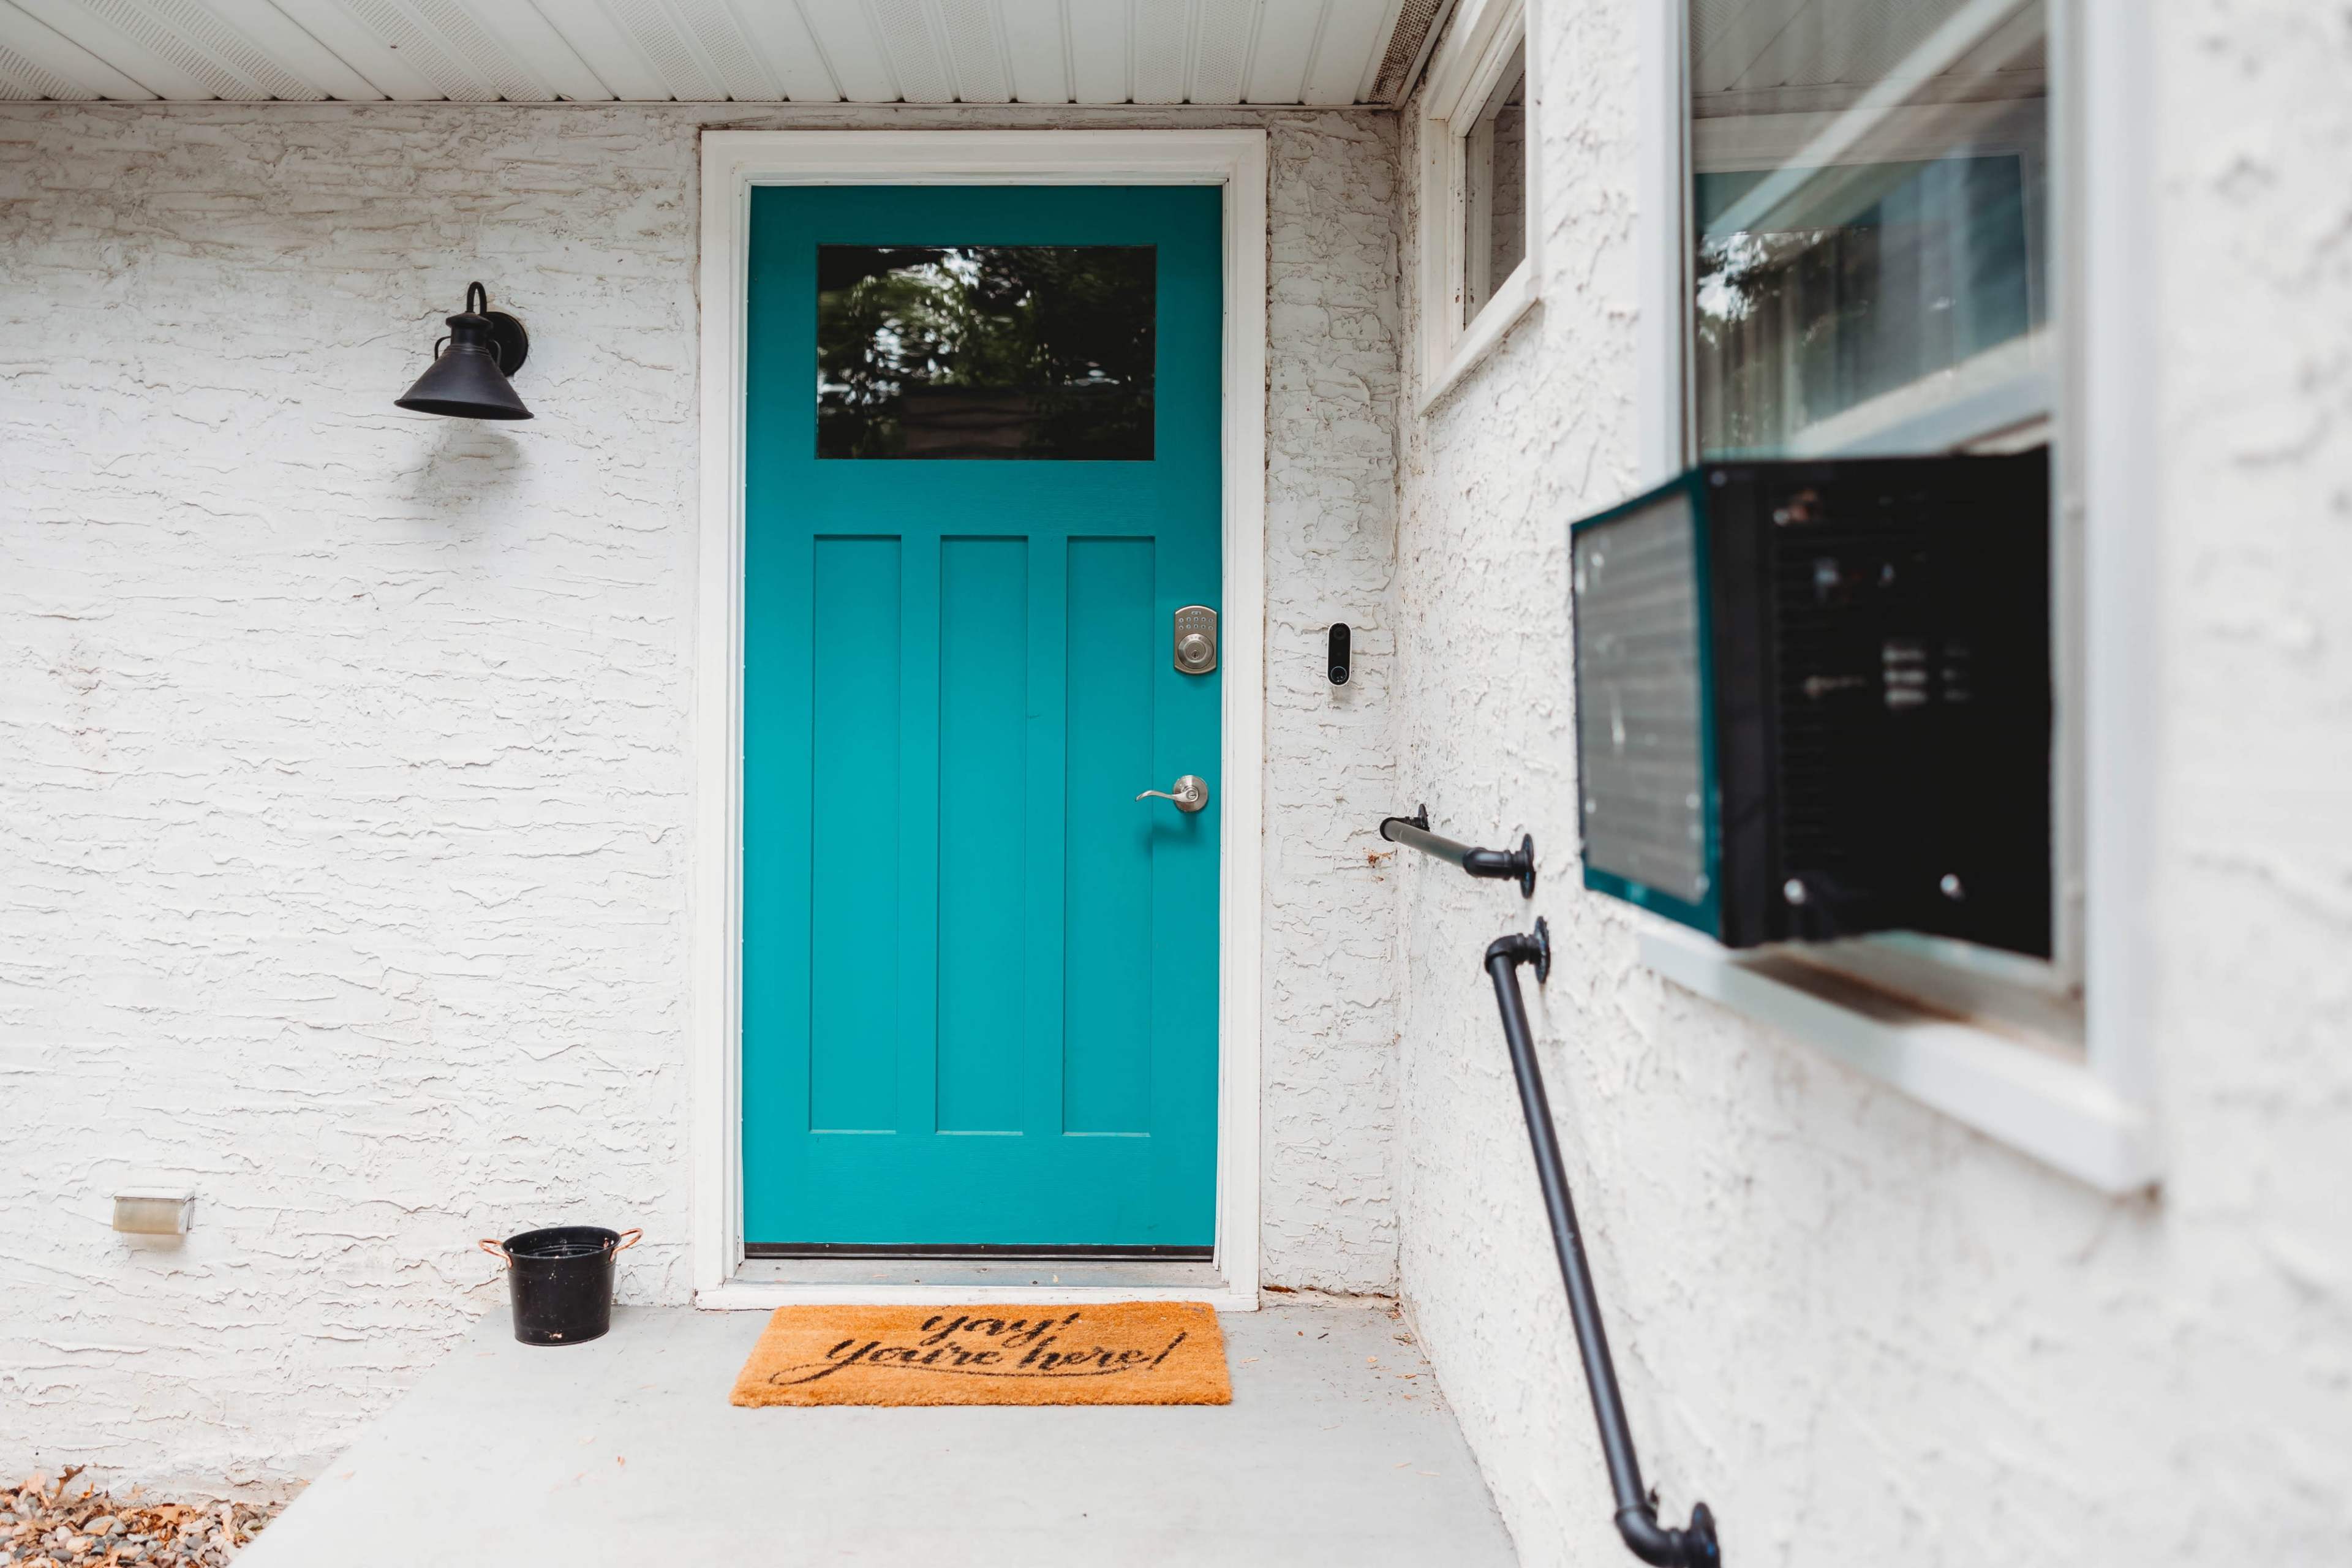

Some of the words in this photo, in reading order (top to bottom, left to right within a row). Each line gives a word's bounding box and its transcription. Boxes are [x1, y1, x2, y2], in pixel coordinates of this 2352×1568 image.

[919, 1312, 1080, 1348] yay!
[769, 1339, 1003, 1385] you're
[1017, 1332, 1186, 1370] here!
